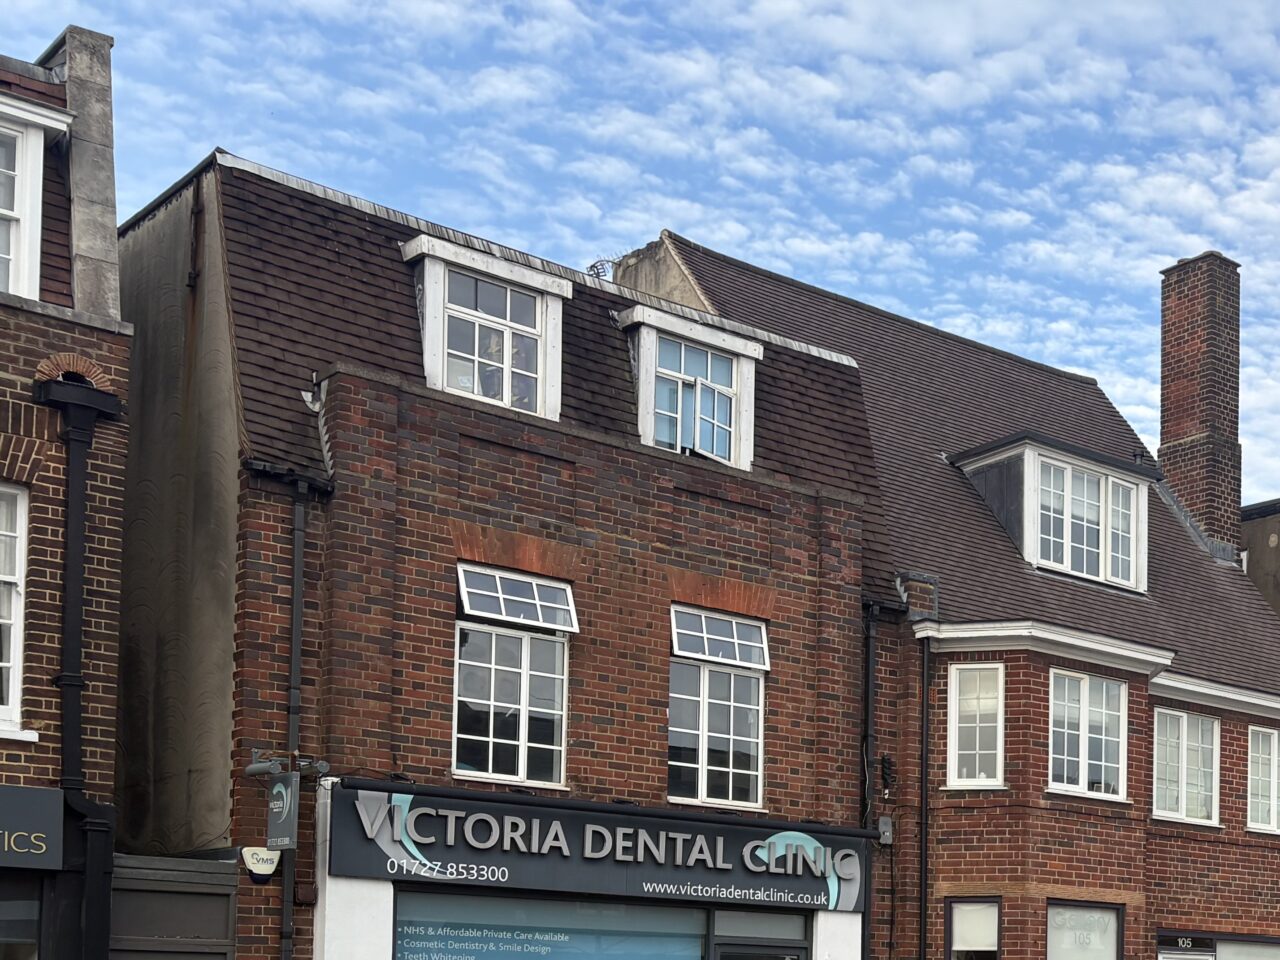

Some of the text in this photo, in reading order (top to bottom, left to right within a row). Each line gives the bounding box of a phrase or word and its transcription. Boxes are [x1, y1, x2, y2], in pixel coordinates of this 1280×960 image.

[0, 830, 47, 854] ICS
[355, 800, 858, 880] VICTORIA DENTAL CLINIC
[255, 857, 275, 865] VMS
[387, 858, 509, 882] 01727 853300
[642, 880, 828, 905] www.victoriadentalclinic.co.uk
[403, 926, 569, 942] NHS & Affordable Private Care Available
[1074, 931, 1091, 945] 105
[403, 938, 445, 949] Cosmetic
[447, 940, 489, 952] Dentistry
[499, 942, 522, 952] Smile
[523, 944, 551, 955] Design
[1177, 937, 1192, 948] 105
[403, 951, 428, 960] Teeth
